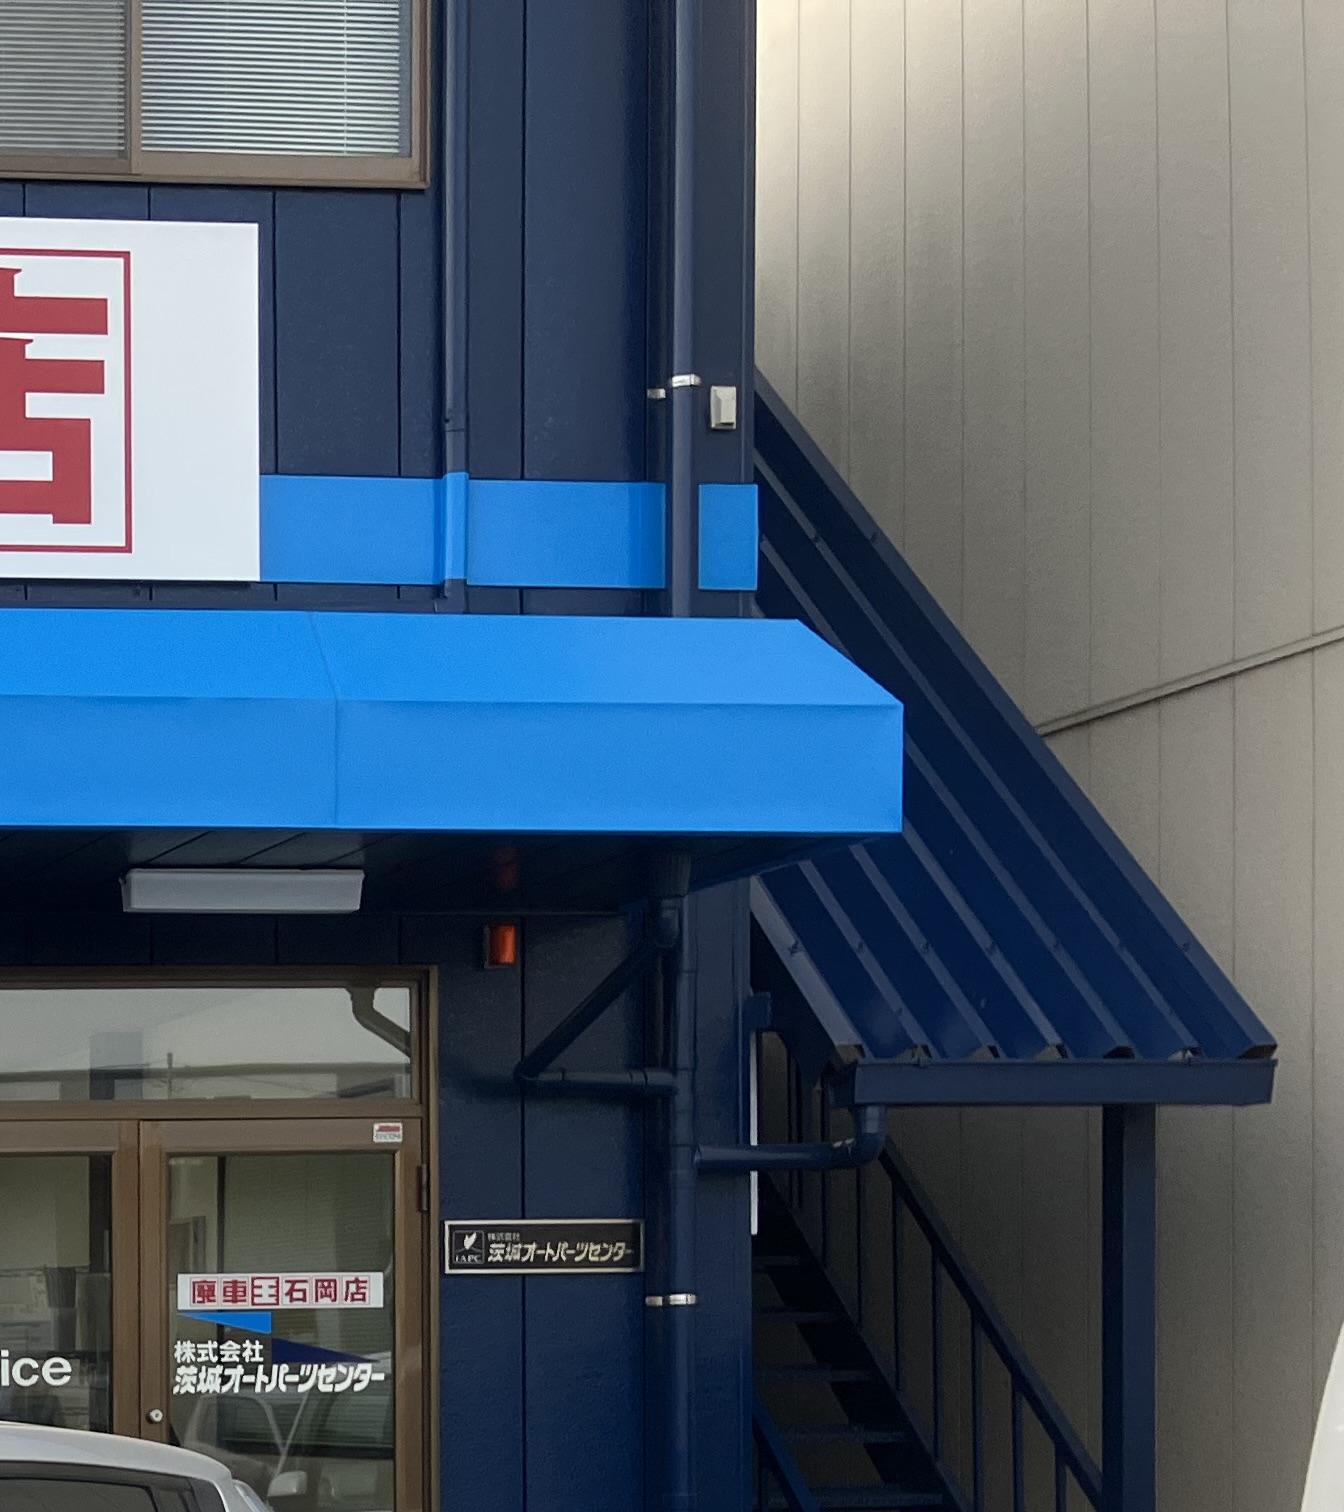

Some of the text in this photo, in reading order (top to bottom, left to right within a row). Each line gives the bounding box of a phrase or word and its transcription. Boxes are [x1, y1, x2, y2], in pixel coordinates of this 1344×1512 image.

[487, 1242, 632, 1262] 茨城オートパーツセンター
[191, 1276, 369, 1306] 廃車王石岡店
[174, 1340, 264, 1363] 株式会社
[172, 1363, 385, 1394] 茨城オートパーツセンター
